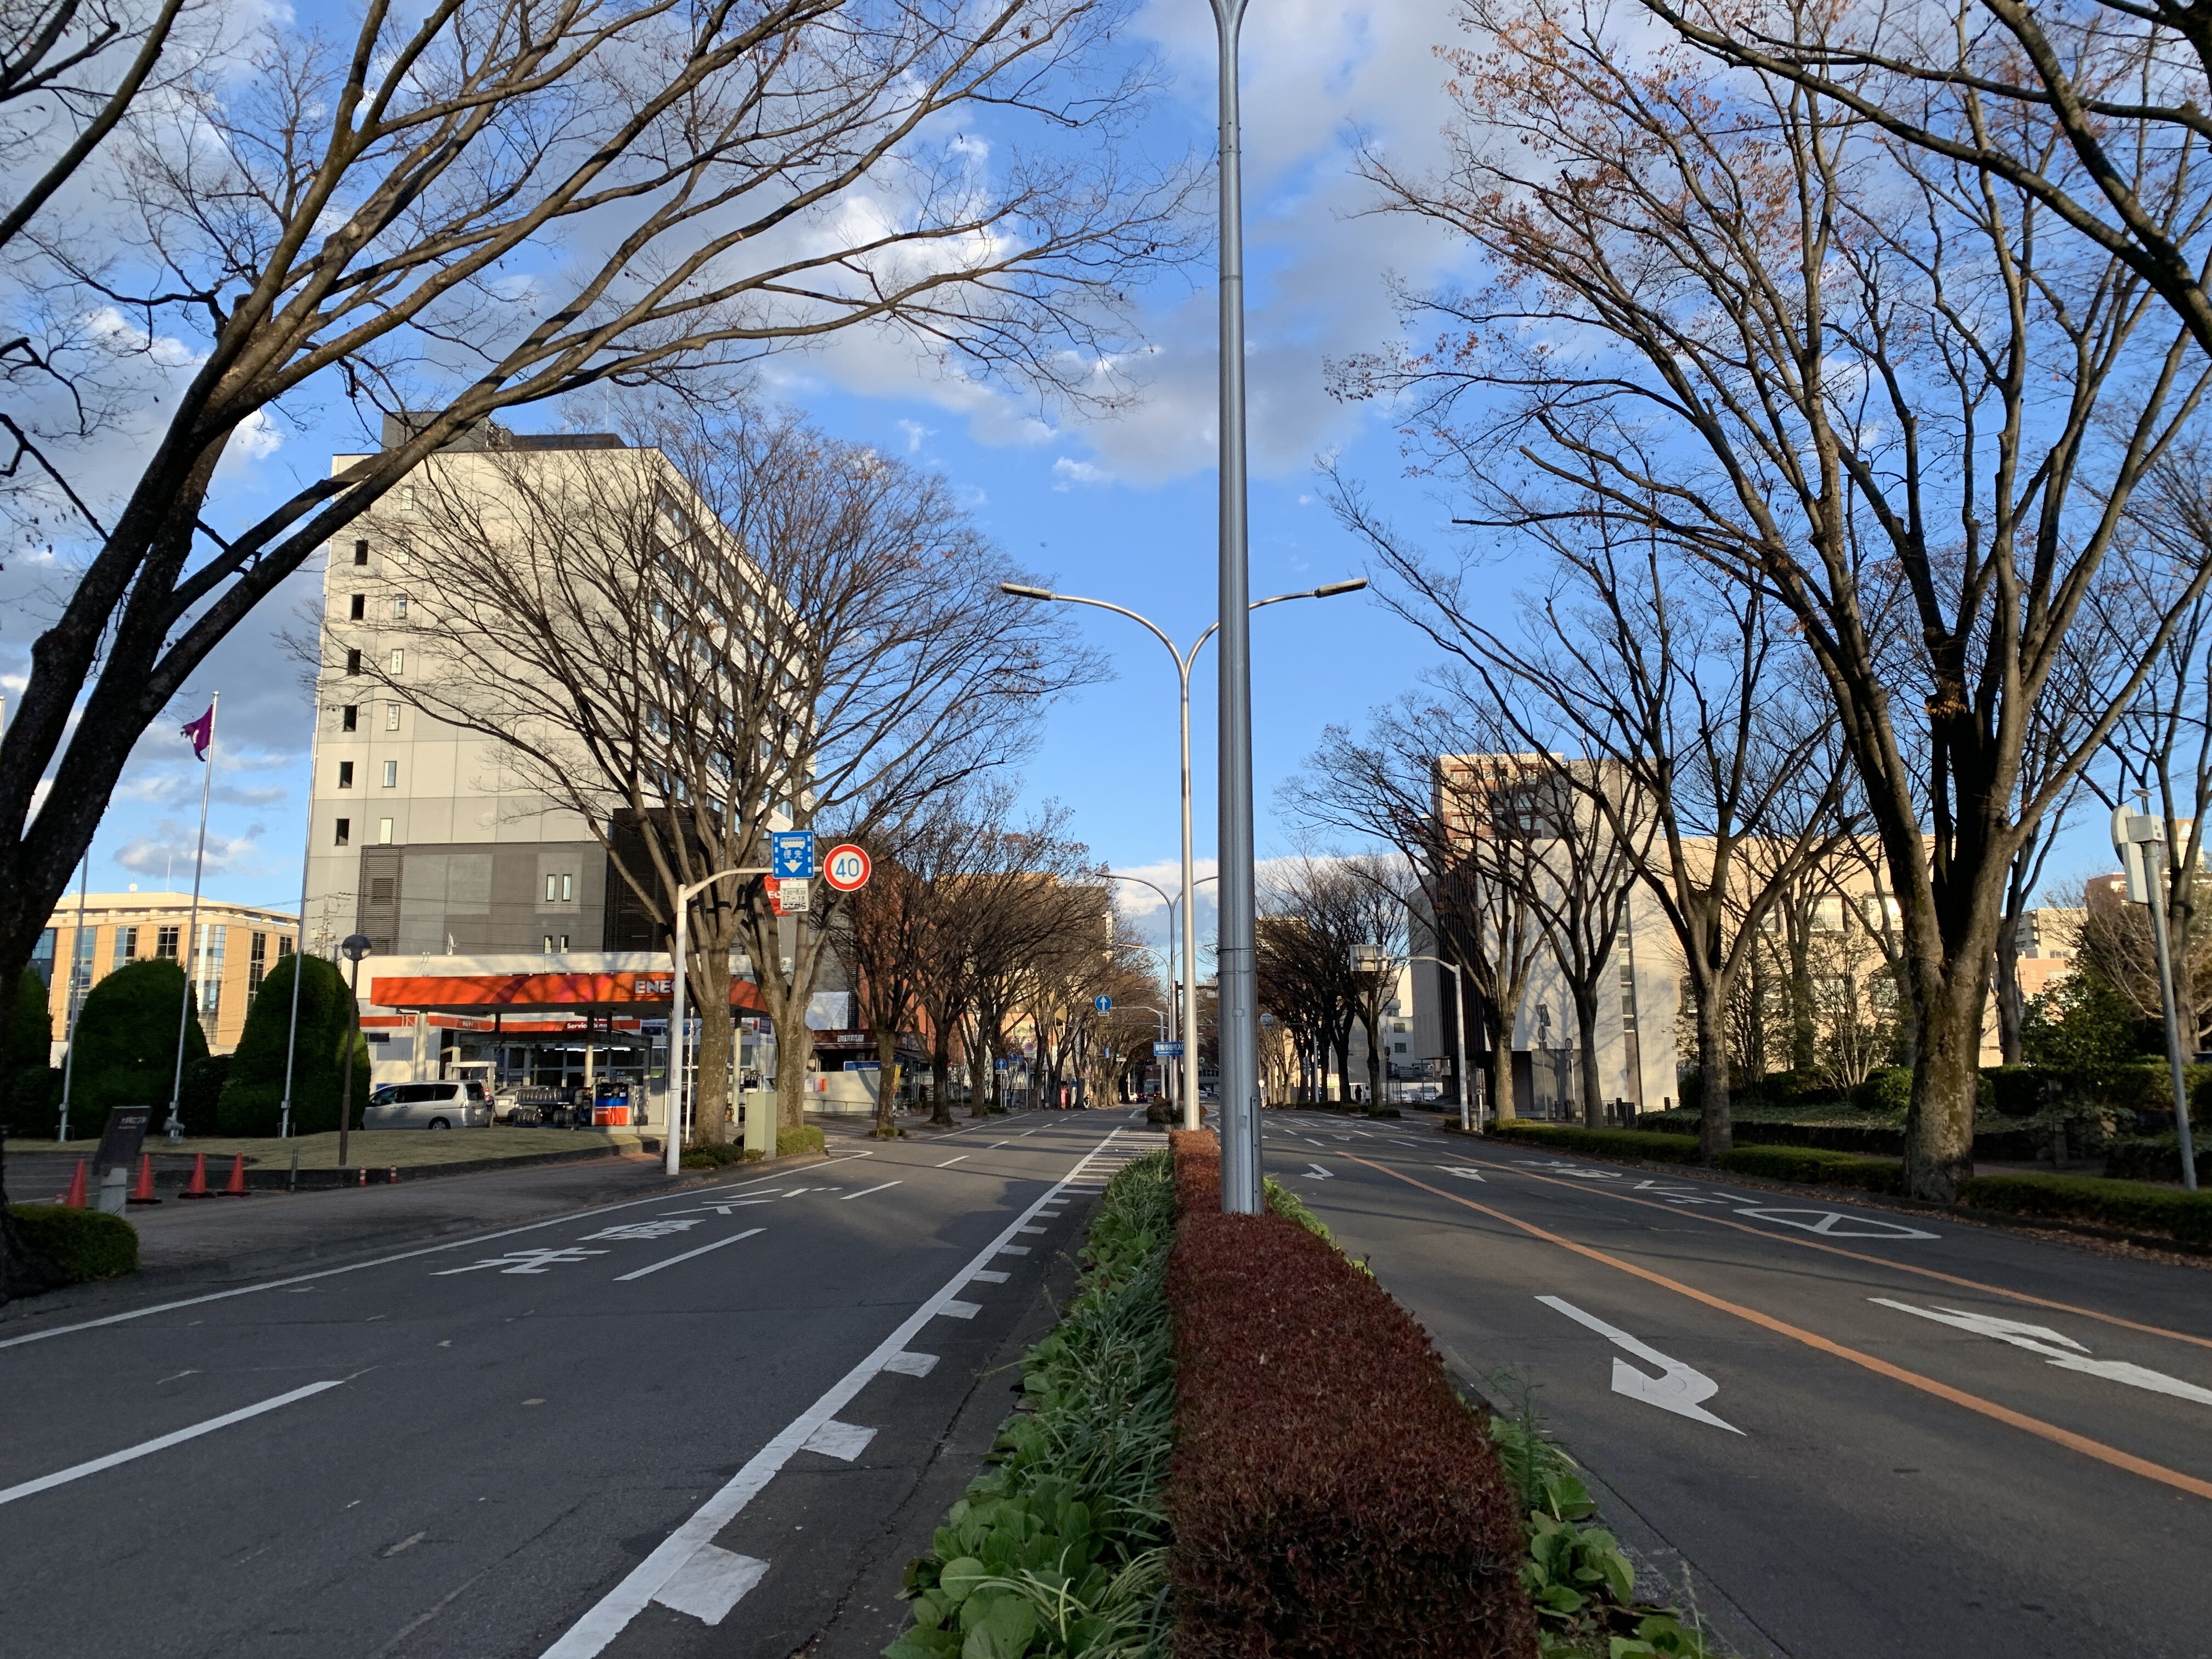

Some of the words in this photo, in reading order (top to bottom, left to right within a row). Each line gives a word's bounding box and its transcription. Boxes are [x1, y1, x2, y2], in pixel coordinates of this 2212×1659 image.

[783, 849, 803, 859] 優先
[835, 857, 860, 878] 40
[635, 980, 674, 994] ENE
